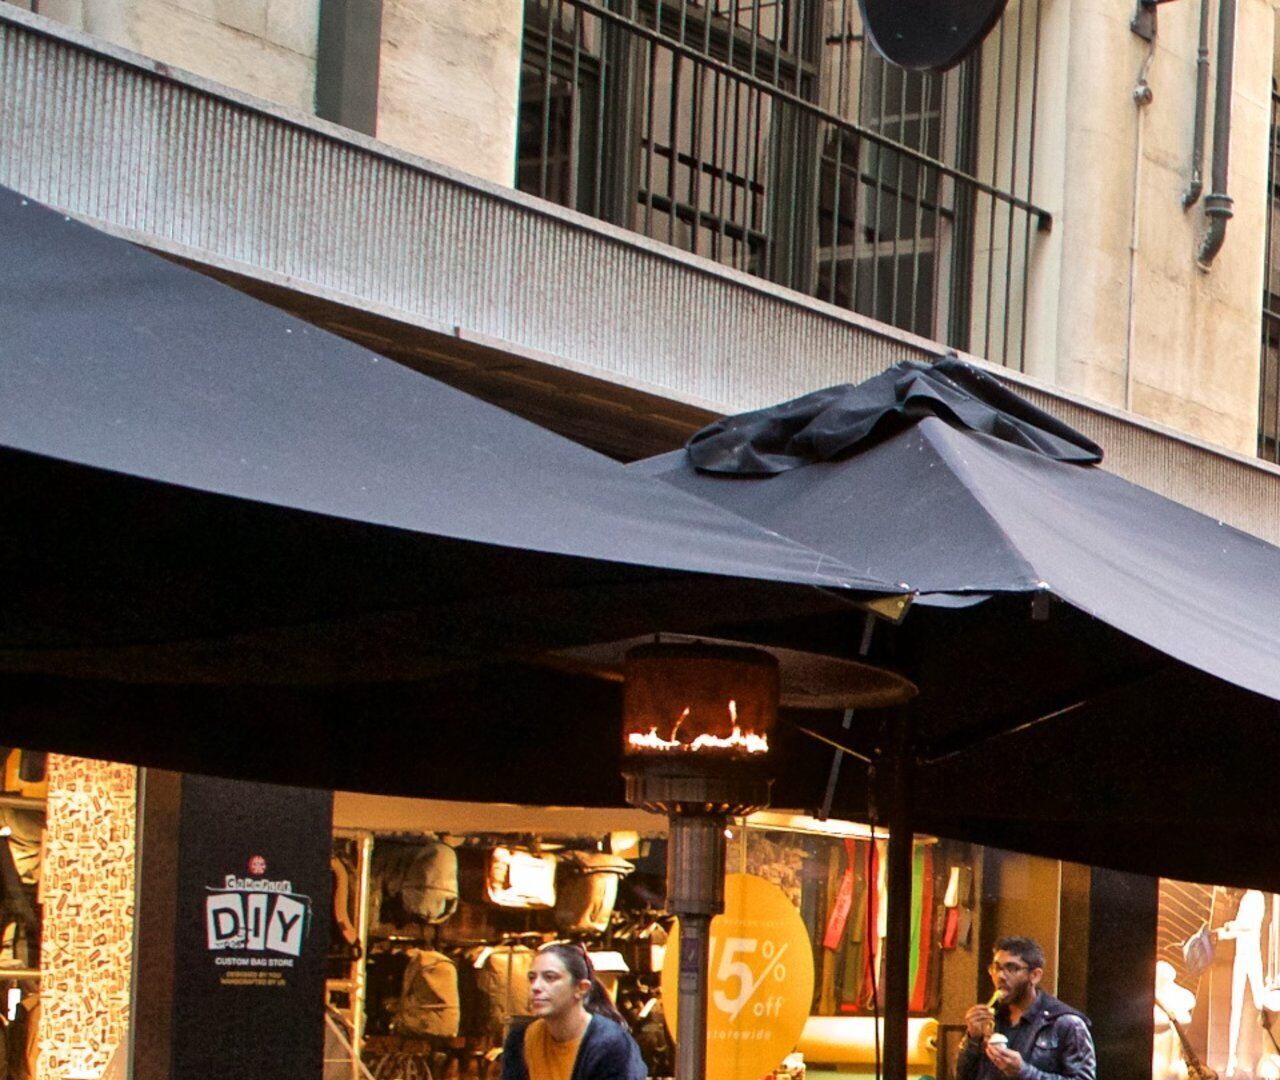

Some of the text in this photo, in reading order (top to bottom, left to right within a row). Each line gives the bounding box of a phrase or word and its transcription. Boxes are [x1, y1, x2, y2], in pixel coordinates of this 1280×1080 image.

[212, 907, 301, 942] DIY
[215, 957, 294, 967] CUSTOM BAG STORE
[752, 996, 785, 1017] off
